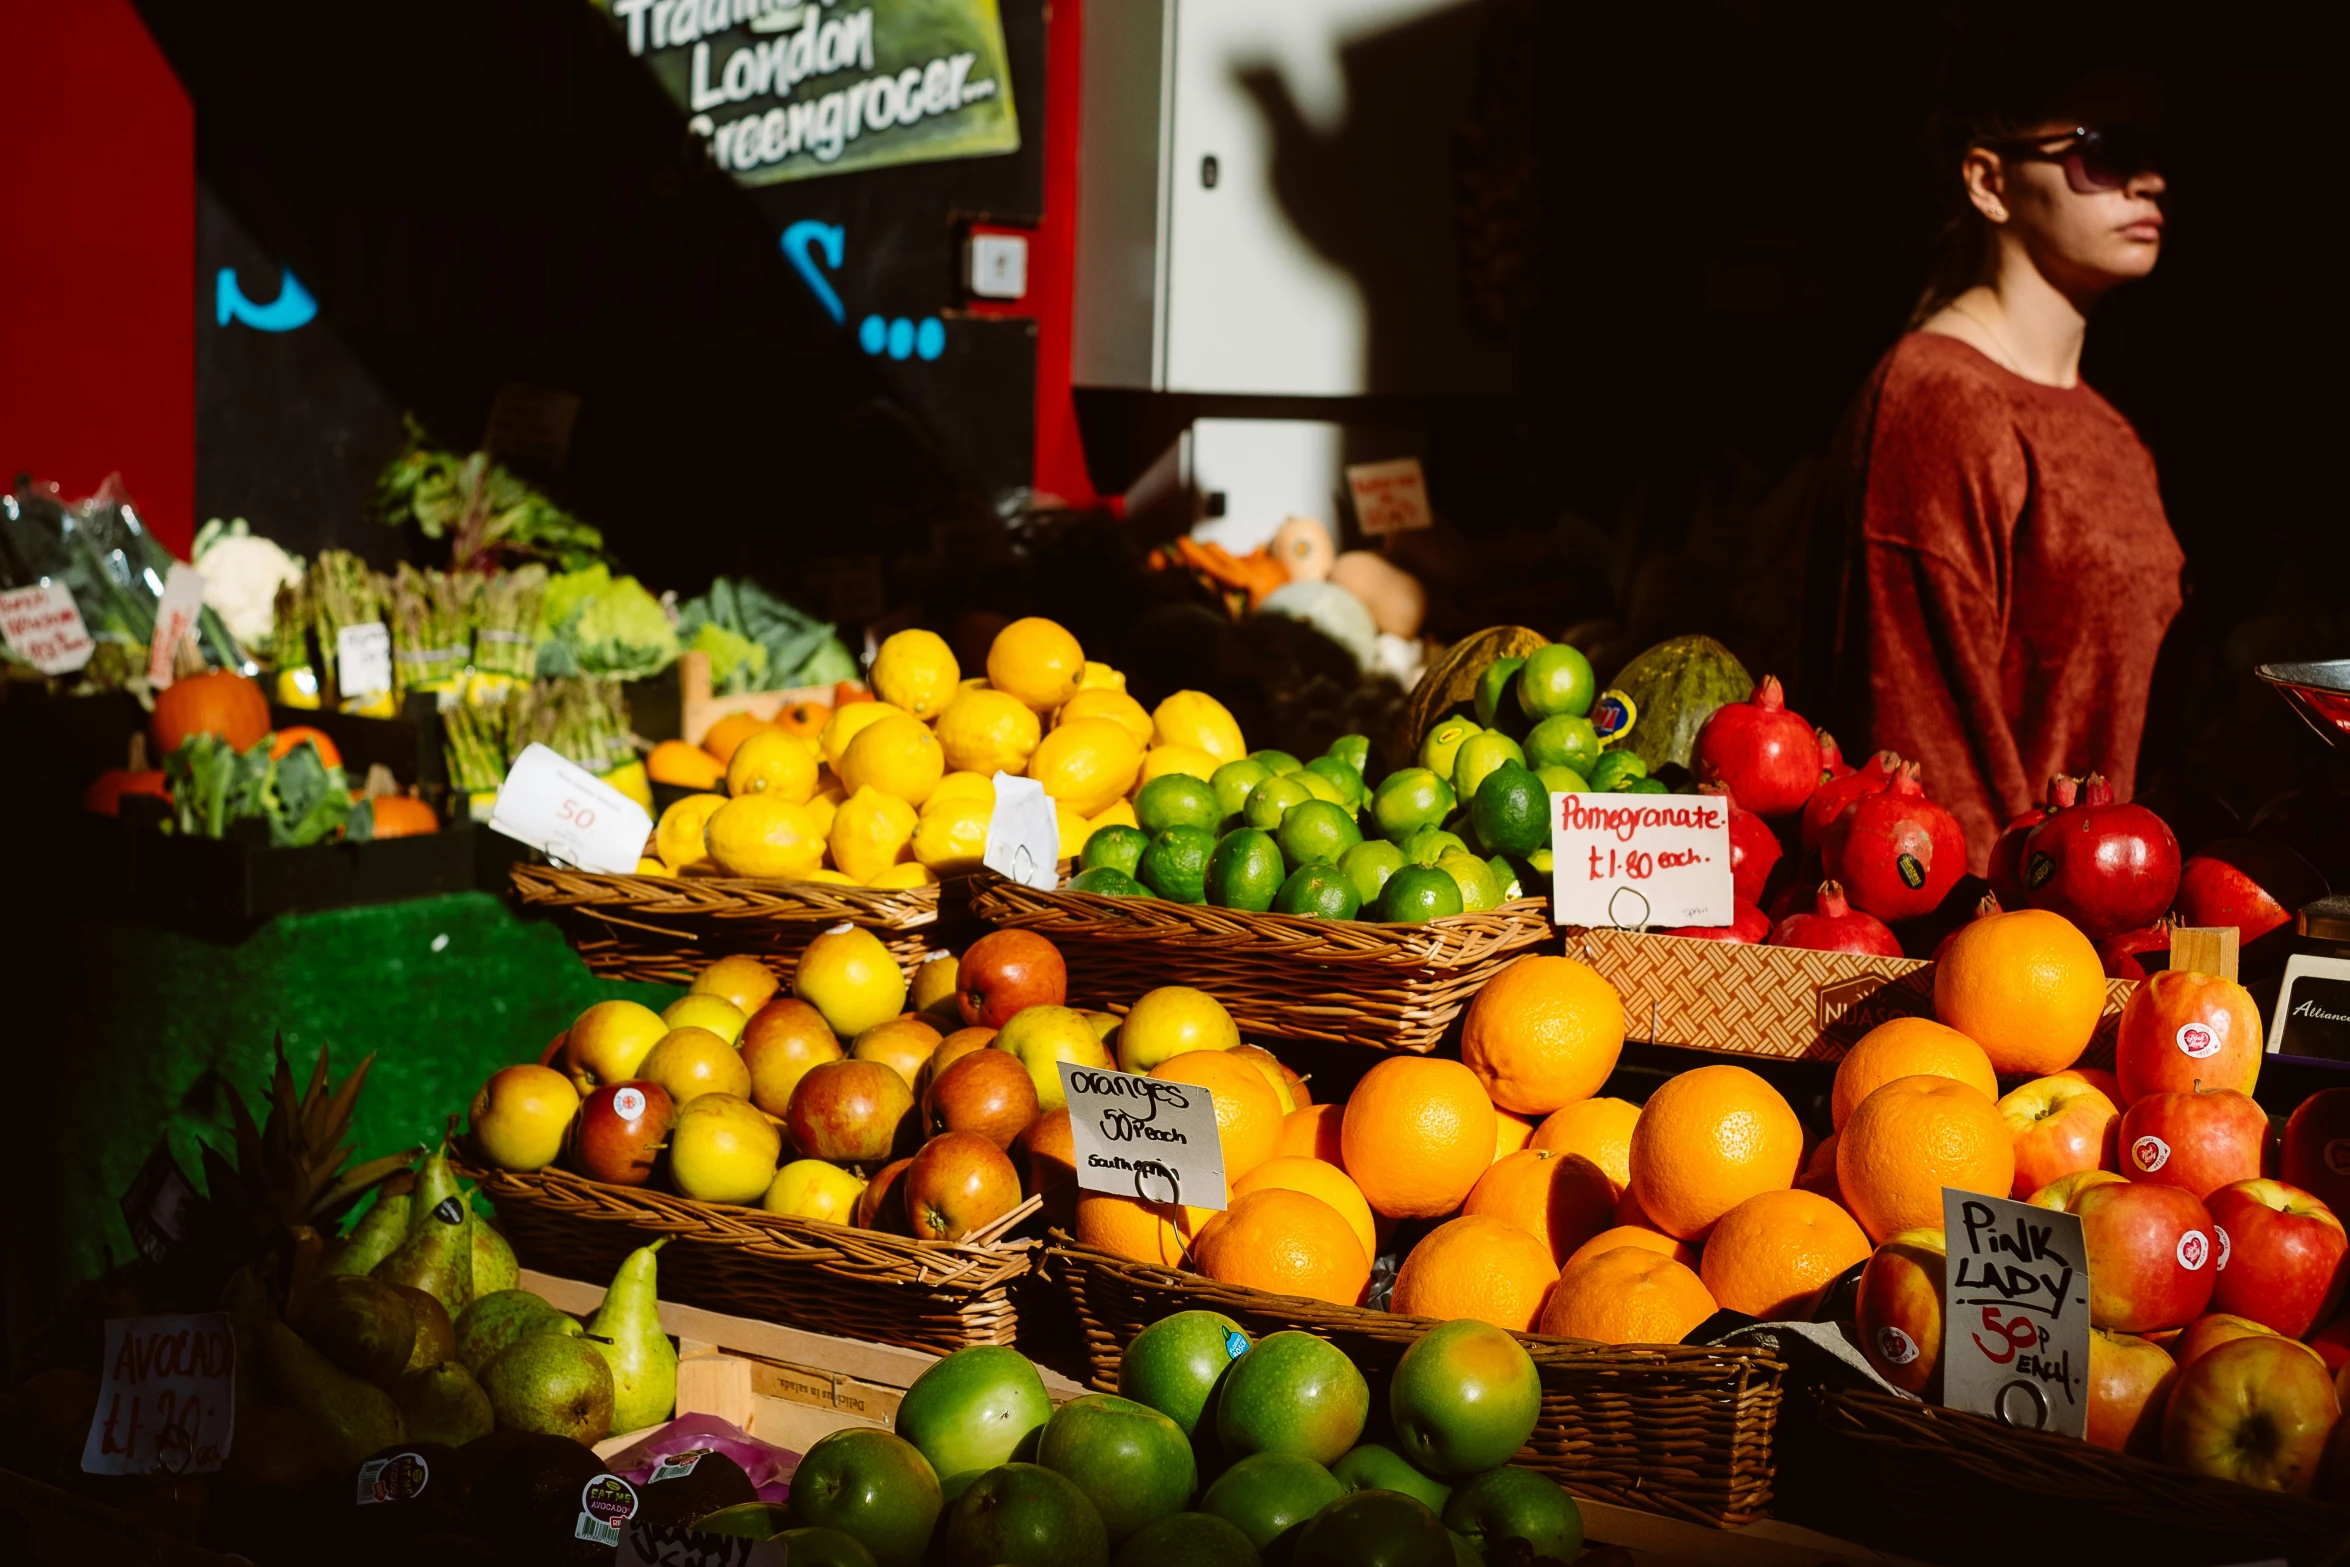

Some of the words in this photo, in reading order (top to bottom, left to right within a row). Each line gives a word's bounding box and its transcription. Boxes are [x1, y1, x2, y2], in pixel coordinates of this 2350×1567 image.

[691, 4, 875, 111] London
[556, 798, 597, 830] 50
[1954, 1257, 2073, 1320] LADY
[822, 1390, 865, 1411] Delicius
[590, 1487, 615, 1502] EAT
[615, 1490, 632, 1504] ME
[590, 1500, 630, 1515] AVOCADO
